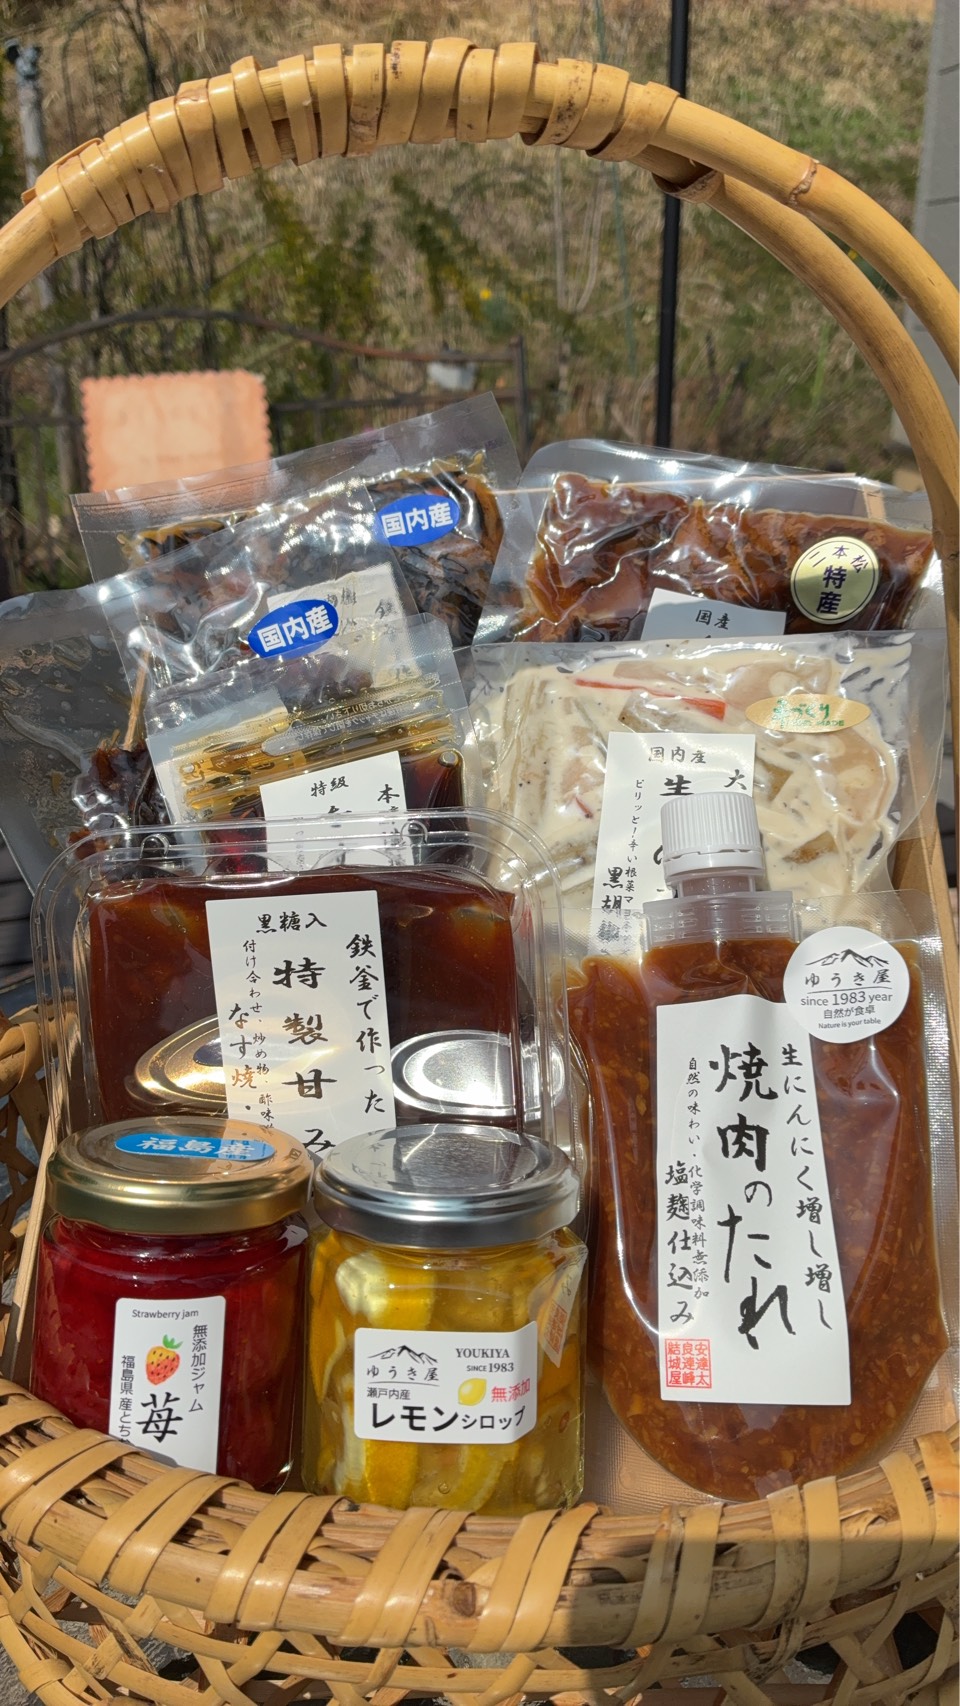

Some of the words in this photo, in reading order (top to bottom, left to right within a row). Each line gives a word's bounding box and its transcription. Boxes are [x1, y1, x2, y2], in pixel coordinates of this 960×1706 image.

[381, 502, 454, 538] 国内産
[809, 545, 869, 574] 二本松
[816, 565, 848, 615] 特産
[257, 604, 334, 652] 国内産
[695, 609, 731, 630] 国産
[648, 746, 707, 764] 国内産
[310, 775, 350, 798] 特級
[255, 911, 328, 934] 黒糖入
[804, 968, 892, 988] ゆうき屋
[800, 996, 829, 1006] since
[831, 991, 866, 1006] 1983
[868, 994, 893, 1003] year
[823, 1004, 876, 1019] 自然が食卓
[848, 1020, 862, 1028] your
[864, 1017, 882, 1026] table
[345, 933, 386, 1114] 鉄釜で作った
[136, 1137, 255, 1157] 福島産
[708, 1041, 797, 1350] 焼肉のたれ
[781, 1043, 832, 1330] 生にんにく増し増し
[665, 1160, 694, 1325] 塩麹仕込み
[131, 1309, 181, 1320] Strawberry
[182, 1309, 199, 1320] jam
[455, 1348, 511, 1359] YOUKIYA
[188, 1324, 208, 1413] 無添加ジャム
[366, 1364, 440, 1382] ゆうき屋
[466, 1364, 487, 1372] SINCE
[488, 1362, 515, 1373] 1983
[366, 1386, 411, 1400] 瀬戸内産
[490, 1377, 531, 1403] 無添加
[135, 1391, 184, 1444] 苺
[371, 1403, 526, 1432] レモンシロップ
